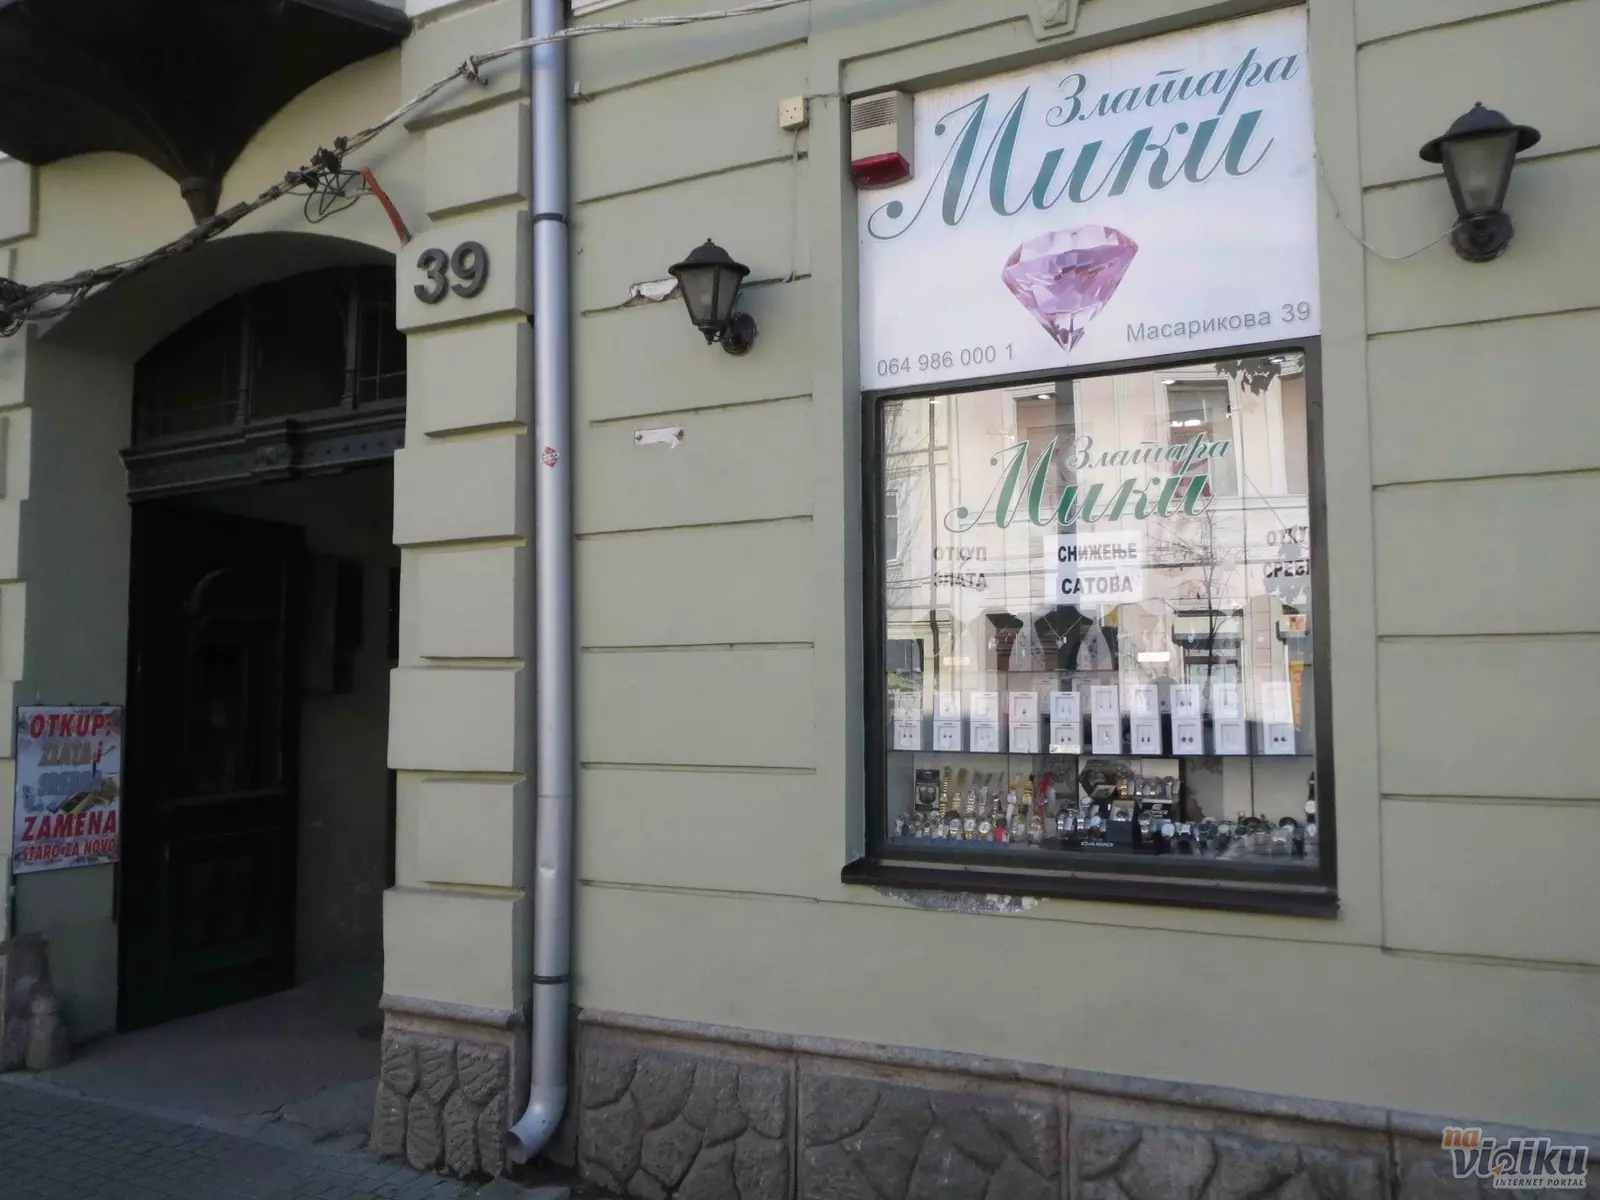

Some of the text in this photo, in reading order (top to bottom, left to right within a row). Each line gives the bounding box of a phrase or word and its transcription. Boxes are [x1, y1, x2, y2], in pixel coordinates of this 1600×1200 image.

[1045, 47, 1299, 128] Златара
[867, 85, 1274, 240] Мики
[414, 241, 490, 304] 39
[1126, 301, 1312, 343] Масарикова 39
[877, 343, 1014, 377] 064 986 000 1
[1064, 432, 1233, 473] Златара
[943, 434, 1216, 533] Мики
[1058, 543, 1138, 562] СНИЖЕЊЕ
[1061, 575, 1133, 594] САТОВА
[21, 809, 117, 842] ZAMENA
[22, 844, 59, 862] STARO
[84, 838, 116, 856] NOVO
